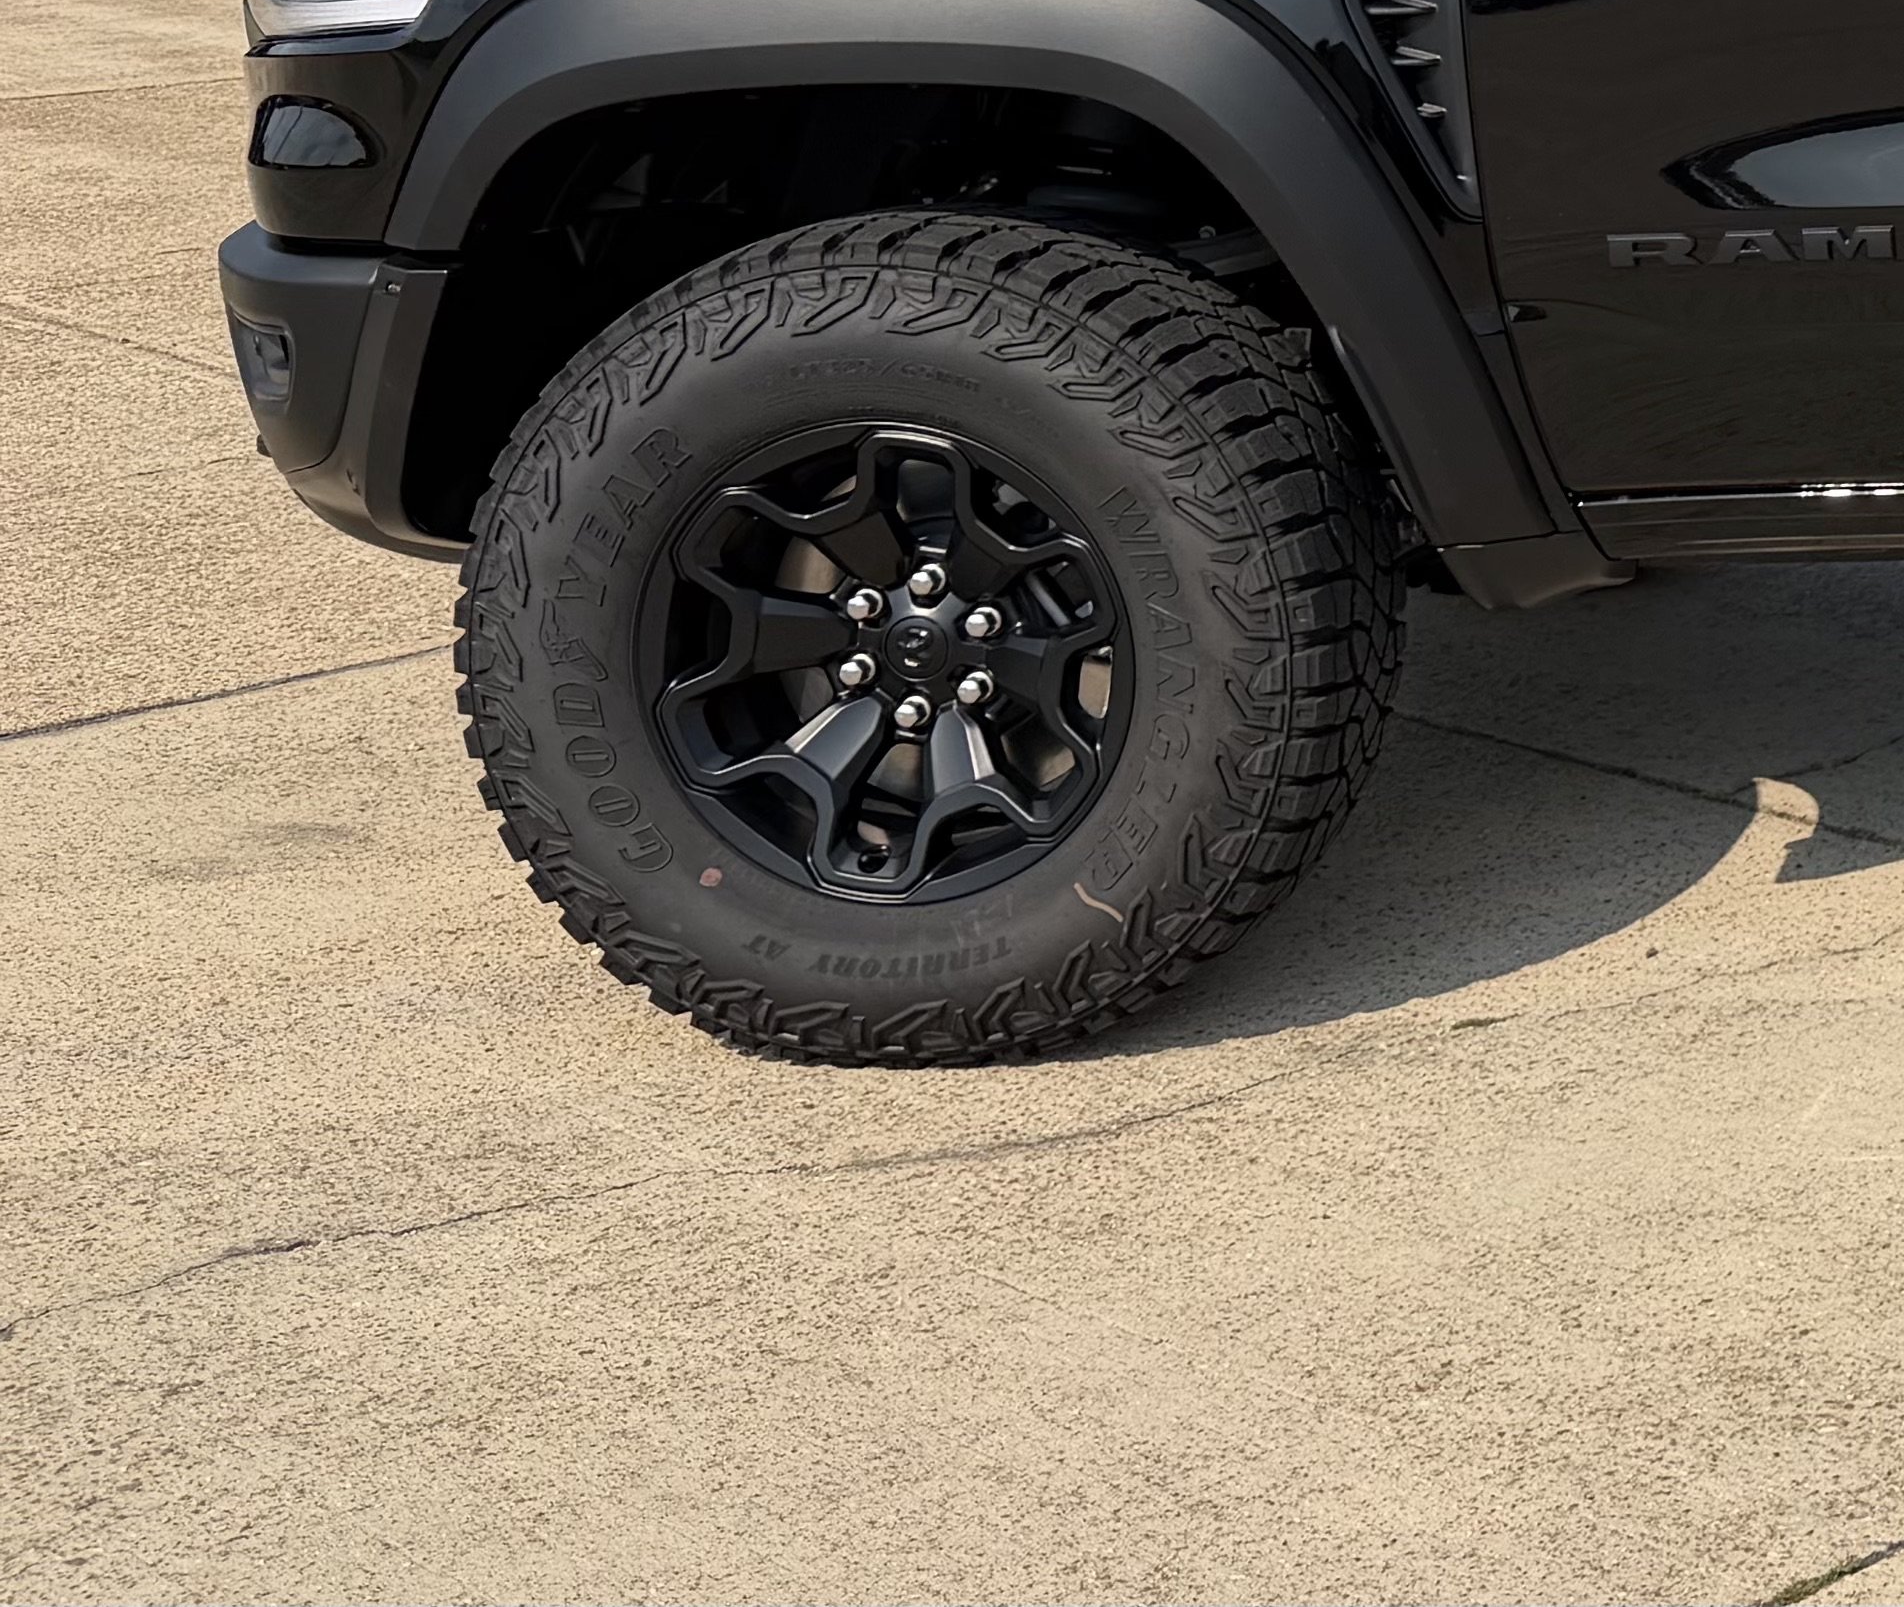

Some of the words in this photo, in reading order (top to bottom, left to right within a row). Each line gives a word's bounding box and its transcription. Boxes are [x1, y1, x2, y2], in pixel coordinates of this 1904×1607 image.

[1607, 224, 1897, 268] RAM
[540, 425, 694, 873] GOODYEAR
[1082, 485, 1197, 891] WRANGLER
[741, 934, 793, 961] AT
[808, 935, 1014, 979] TERRITORY
